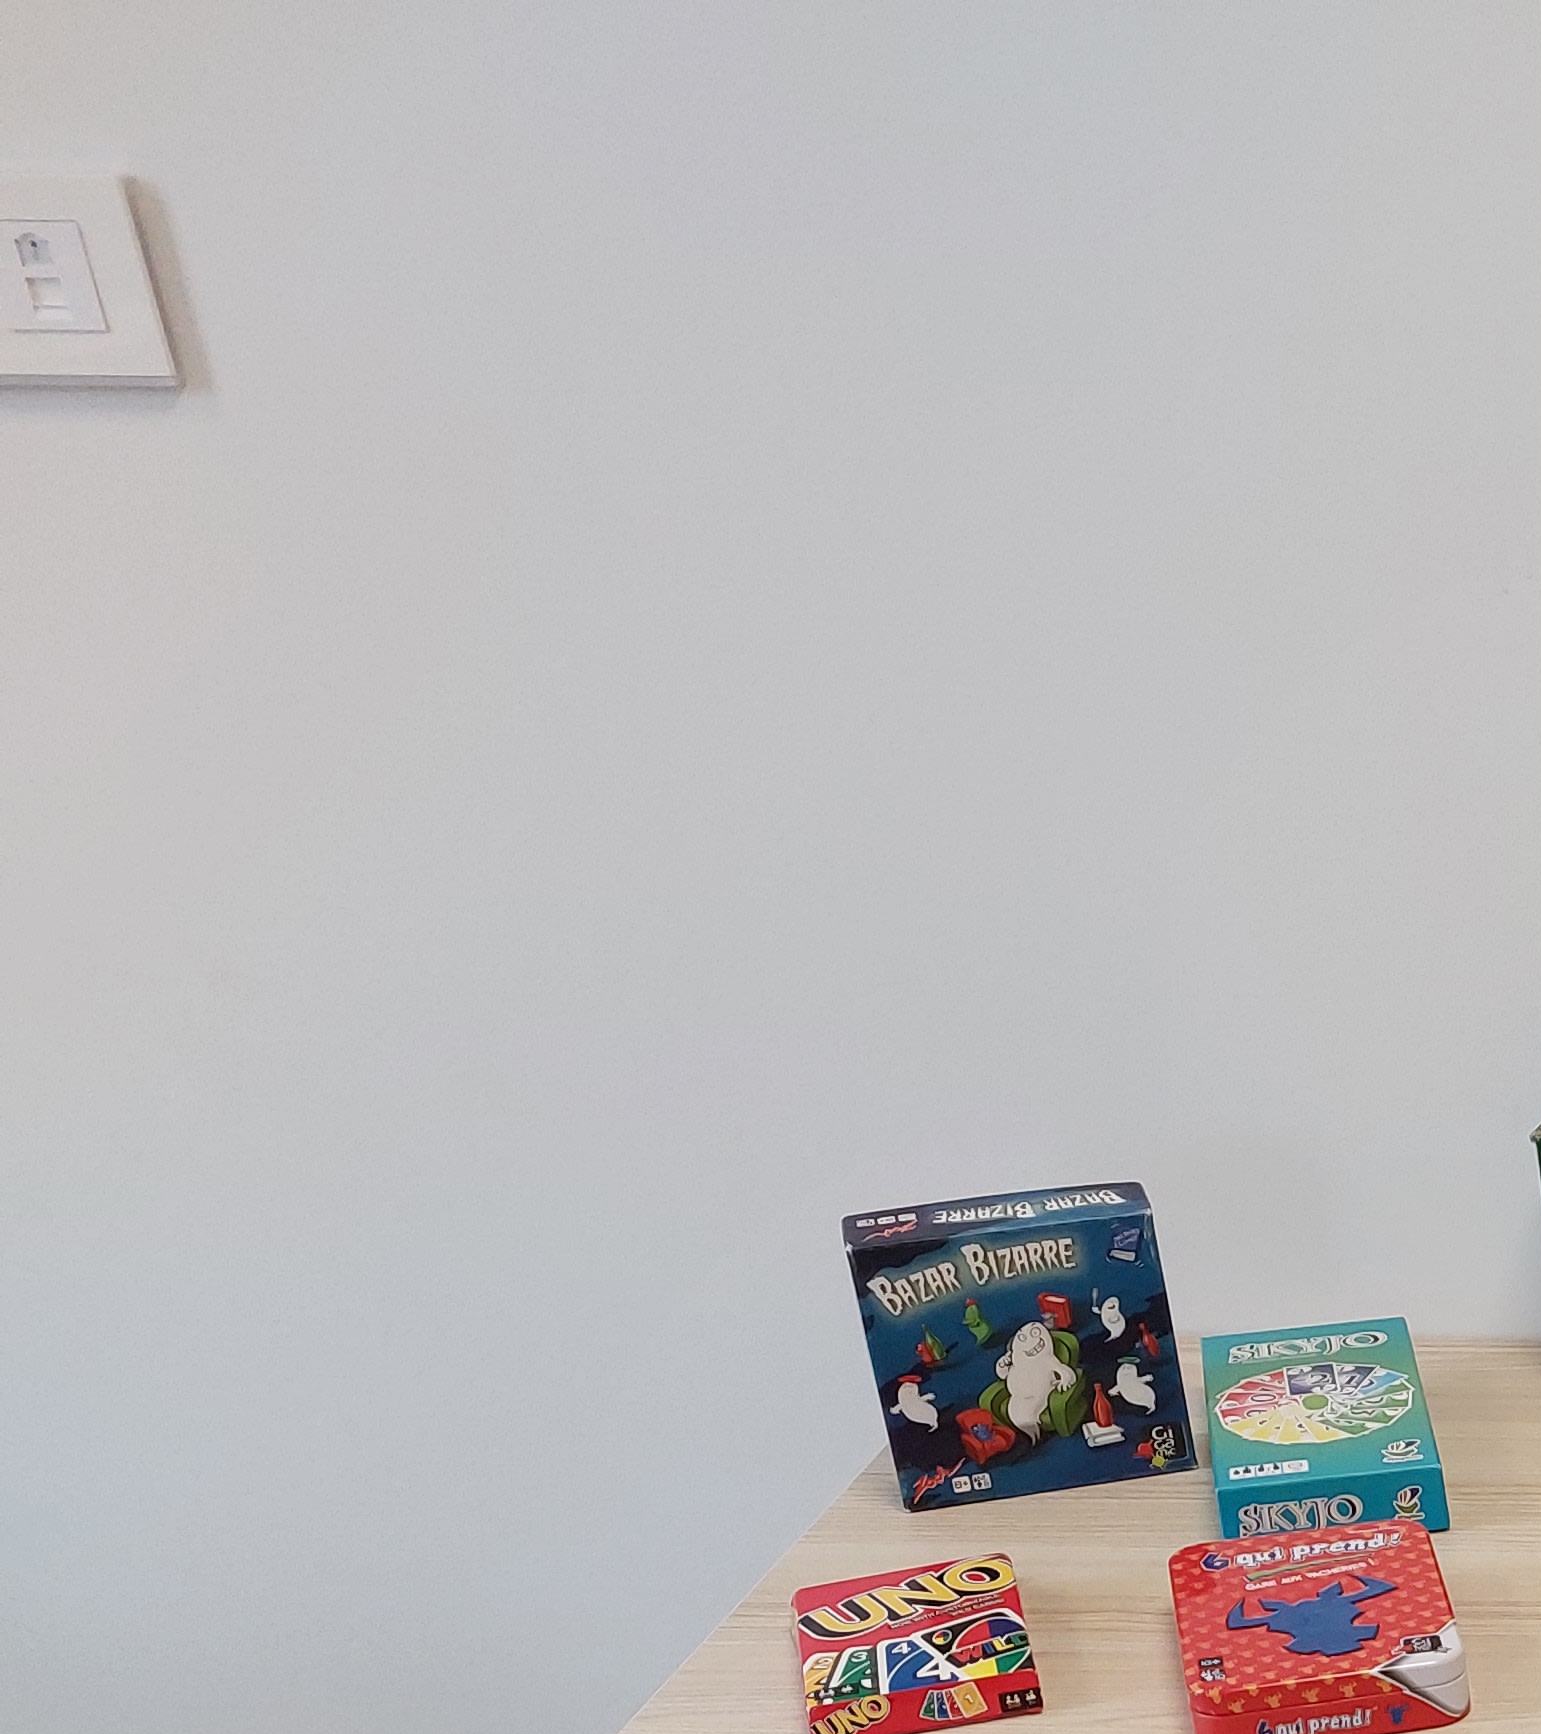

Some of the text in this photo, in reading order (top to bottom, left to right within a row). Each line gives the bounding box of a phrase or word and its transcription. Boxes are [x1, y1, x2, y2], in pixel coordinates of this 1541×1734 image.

[932, 1201, 1038, 1225] BIZARRE
[1043, 1188, 1127, 1211] BAZAR
[866, 1237, 1077, 1317] BAZAR BIZARRE
[1228, 1331, 1388, 1364] SKYJO
[1238, 1494, 1364, 1537] SKYJO
[1201, 1550, 1231, 1572] 6
[1234, 1546, 1288, 1568] qui
[798, 1556, 1018, 1642] UNO
[949, 1631, 1030, 1668] WILD
